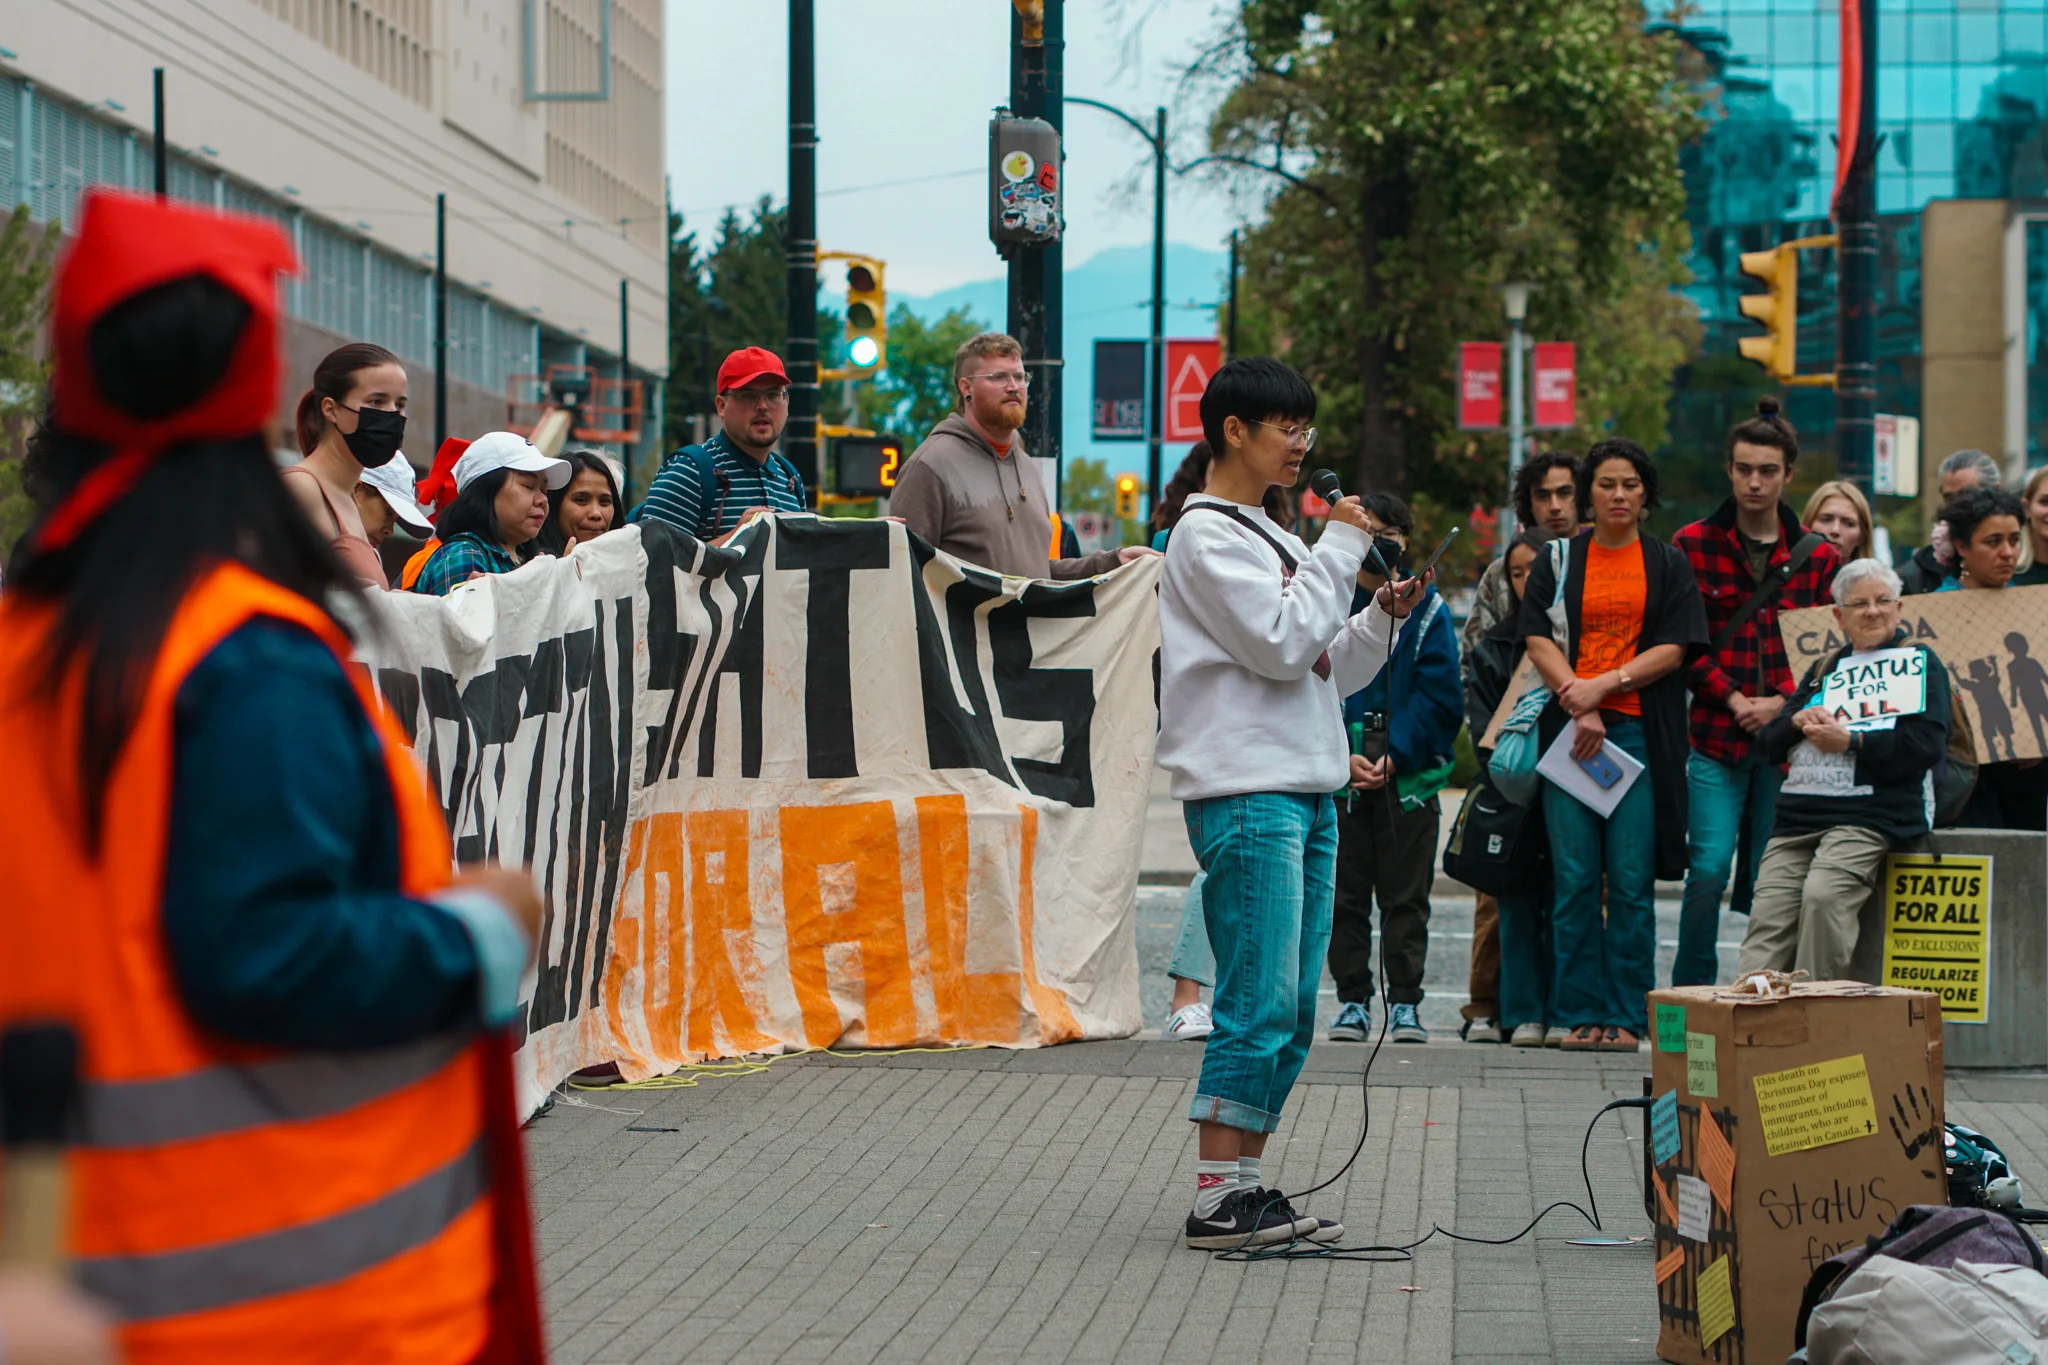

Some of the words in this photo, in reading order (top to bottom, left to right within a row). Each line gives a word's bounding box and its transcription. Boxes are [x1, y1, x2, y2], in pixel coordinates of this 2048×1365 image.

[880, 447, 898, 486] 2
[640, 516, 1097, 808] STATUS
[1829, 656, 1923, 690] STATUS
[1848, 681, 1888, 700] FOR
[1834, 700, 1900, 723] ALL
[1894, 875, 1981, 897] STATUS
[1893, 902, 1938, 923] FOR
[1942, 903, 1981, 924] ALL
[605, 807, 783, 1082] FOR
[777, 792, 1085, 1051] ALL
[1893, 939, 1909, 950] NO
[1912, 939, 1981, 953] EXCLUSIONS
[1891, 967, 1979, 982] REGULARIZE
[1756, 1077, 1777, 1088] This
[1778, 1068, 1806, 1083] death
[1807, 1067, 1820, 1075] on
[1758, 1083, 1807, 1101] Christmas
[1809, 1078, 1827, 1090] Day
[1829, 1070, 1867, 1085] exposes
[1761, 1103, 1777, 1114] the
[1779, 1095, 1817, 1111] number
[1818, 1090, 1829, 1100] of
[1763, 1108, 1822, 1128] immigrants,
[1823, 1096, 1868, 1114] including
[1766, 1123, 1809, 1141] children,
[1810, 1119, 1832, 1131] who
[1833, 1115, 1849, 1124] are
[1769, 1136, 1812, 1154] detained
[1813, 1135, 1824, 1144] in
[1825, 1126, 1862, 1142] Canada.
